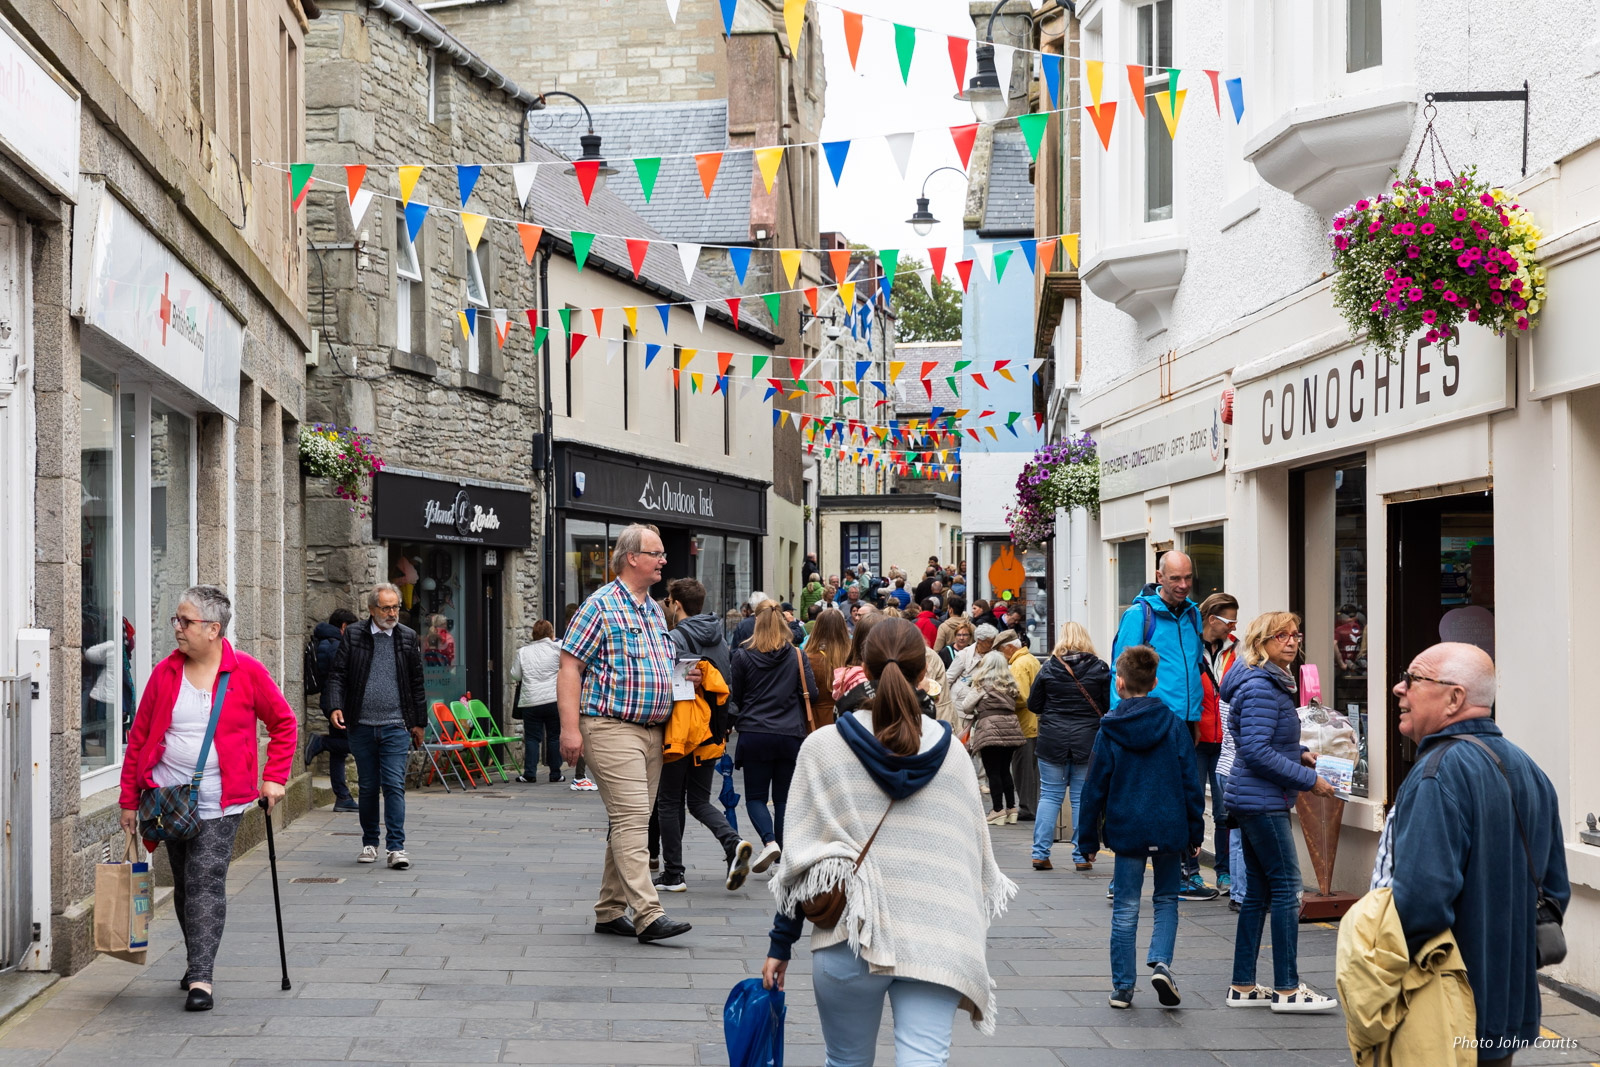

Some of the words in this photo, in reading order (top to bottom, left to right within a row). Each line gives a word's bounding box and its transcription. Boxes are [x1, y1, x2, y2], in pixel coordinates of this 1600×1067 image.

[1262, 326, 1460, 445] CONOCHIES
[1102, 455, 1128, 478] NEWSAGENTS
[1131, 442, 1166, 468] CONFECTIONERY
[1171, 436, 1185, 457] GIFTS
[1190, 428, 1208, 451] BOOKS
